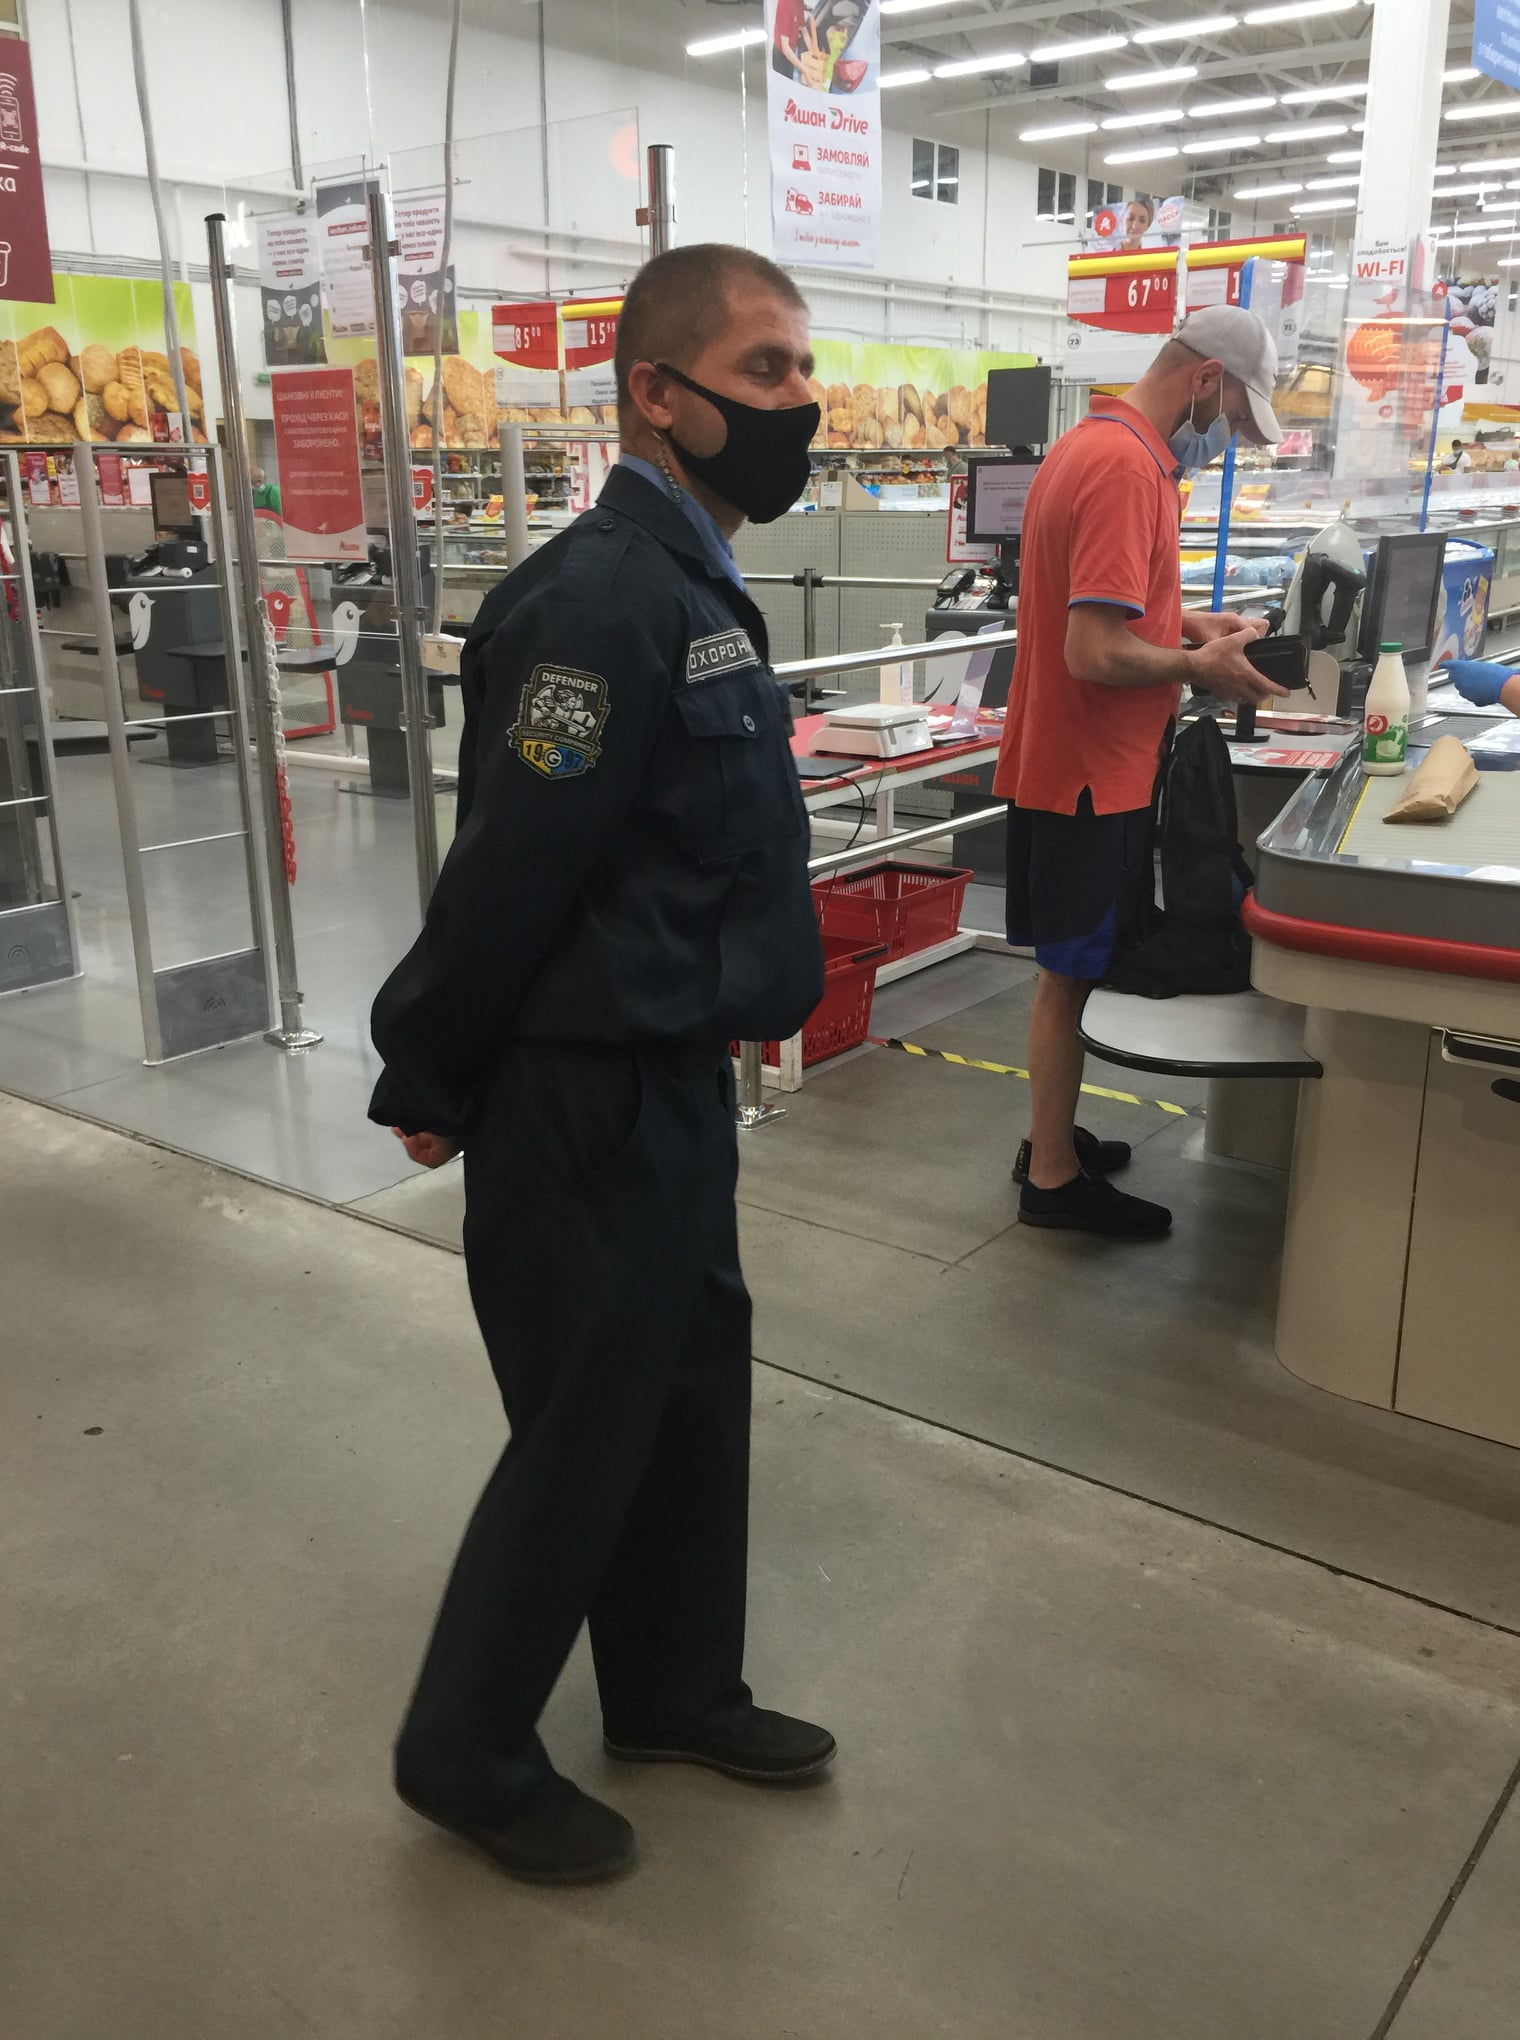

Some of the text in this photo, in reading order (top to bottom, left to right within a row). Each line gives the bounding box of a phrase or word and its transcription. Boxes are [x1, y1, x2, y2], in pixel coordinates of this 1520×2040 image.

[783, 97, 869, 136] Ашан Drive
[816, 146, 870, 168] ЗАМОВЛЯЙ
[818, 191, 862, 209] ЗАБИРАЙ
[1356, 259, 1405, 279] WI-FI
[541, 672, 599, 693] DEFENDER
[521, 730, 554, 740] SECURITY
[525, 743, 544, 763] 19
